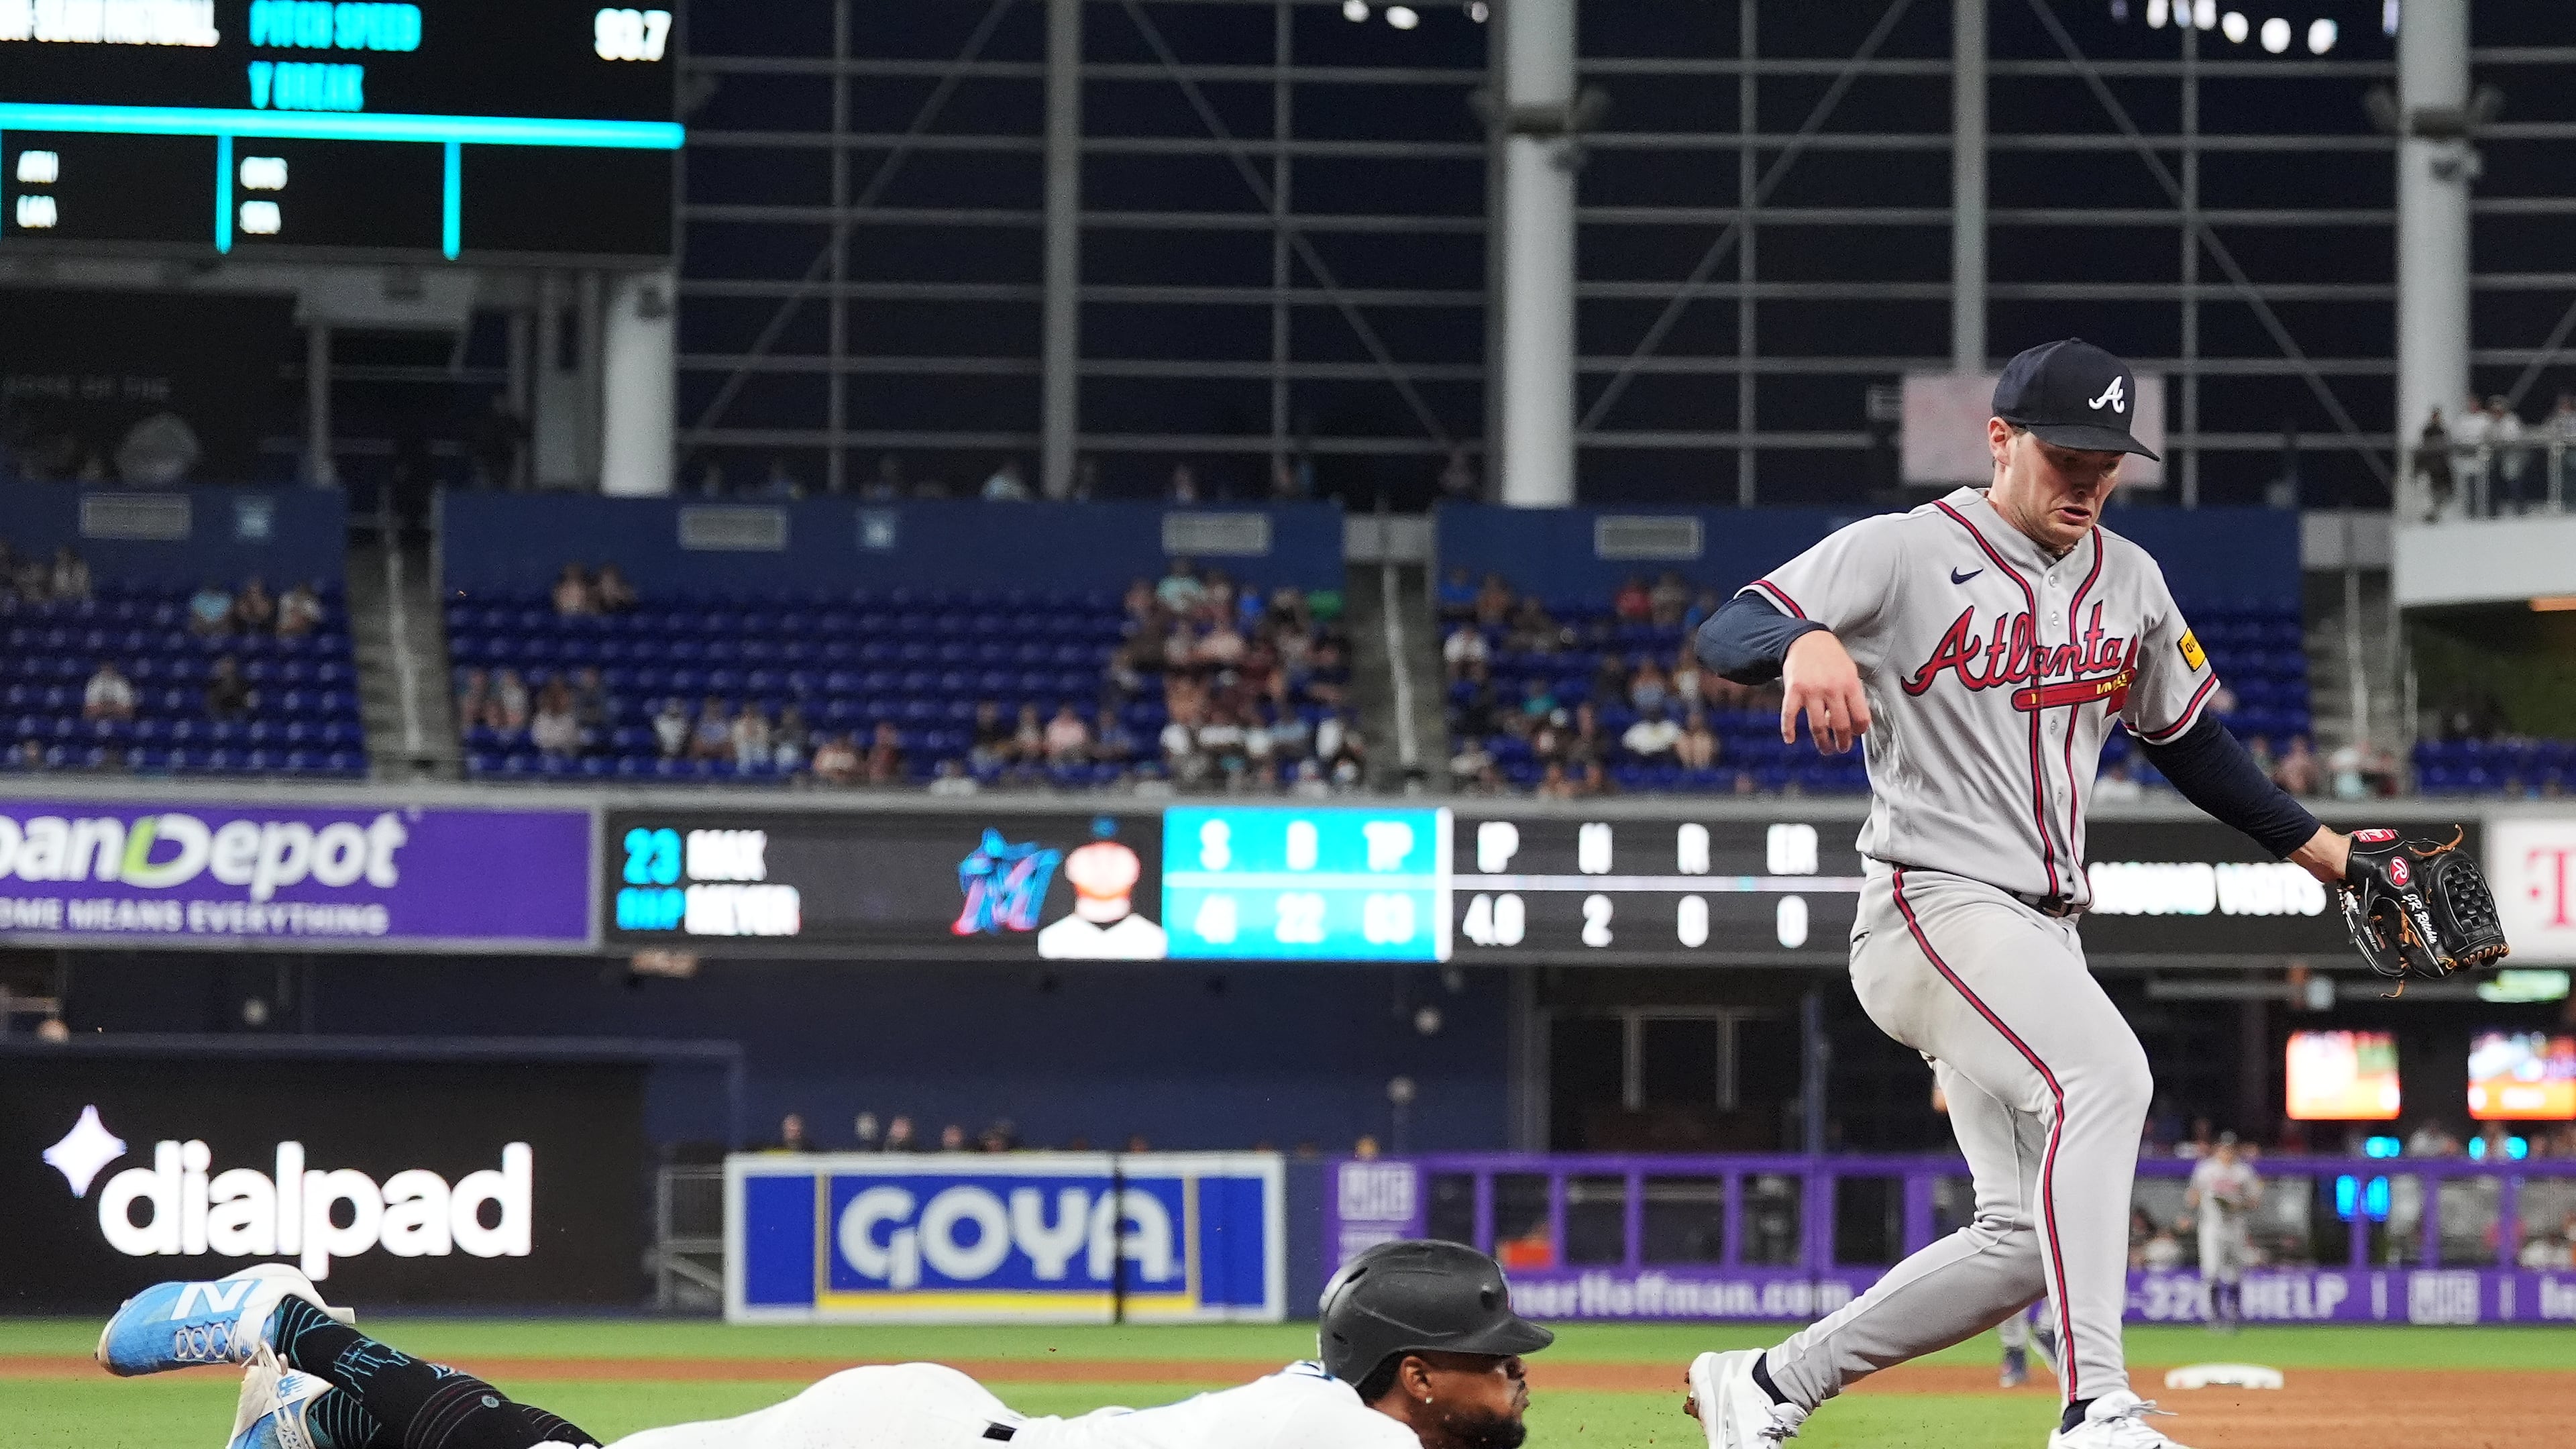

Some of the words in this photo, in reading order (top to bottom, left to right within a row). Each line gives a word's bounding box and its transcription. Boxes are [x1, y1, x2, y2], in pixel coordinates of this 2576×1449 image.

[2088, 376, 2125, 414] A
[1901, 599, 2123, 696] Atlanta
[623, 828, 682, 884] 23
[2525, 847, 2576, 929] T
[68, 898, 184, 932] MEANS
[186, 901, 389, 936] EVERYTHING
[1582, 894, 1613, 947] 2
[98, 1140, 533, 1281] dialpad
[838, 1185, 1172, 1291] GOYA
[2240, 1274, 2348, 1319] HELP
